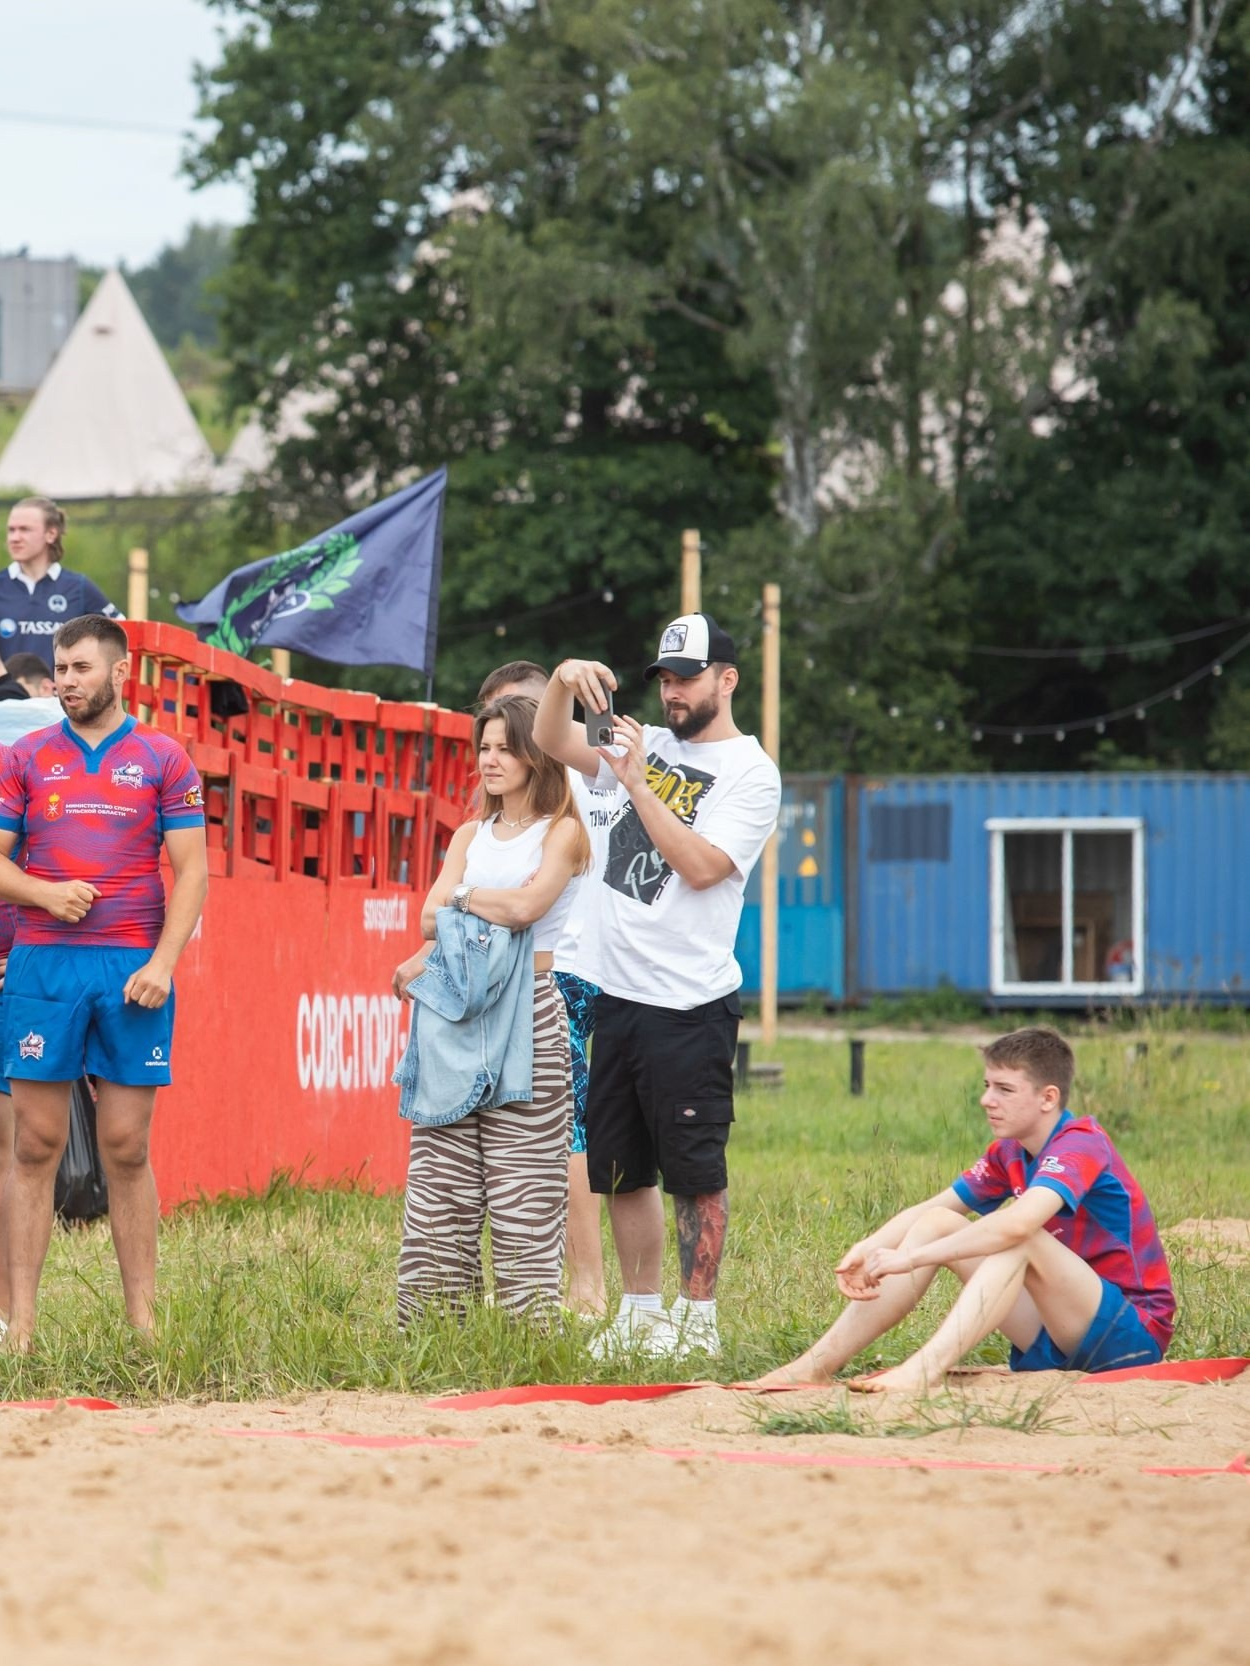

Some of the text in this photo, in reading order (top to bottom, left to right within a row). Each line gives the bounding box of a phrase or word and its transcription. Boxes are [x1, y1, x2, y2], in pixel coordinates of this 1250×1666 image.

[18, 621, 64, 635] TASSA
[97, 809, 126, 817] ОБЛАСТИ
[113, 805, 138, 813] СПОРТА
